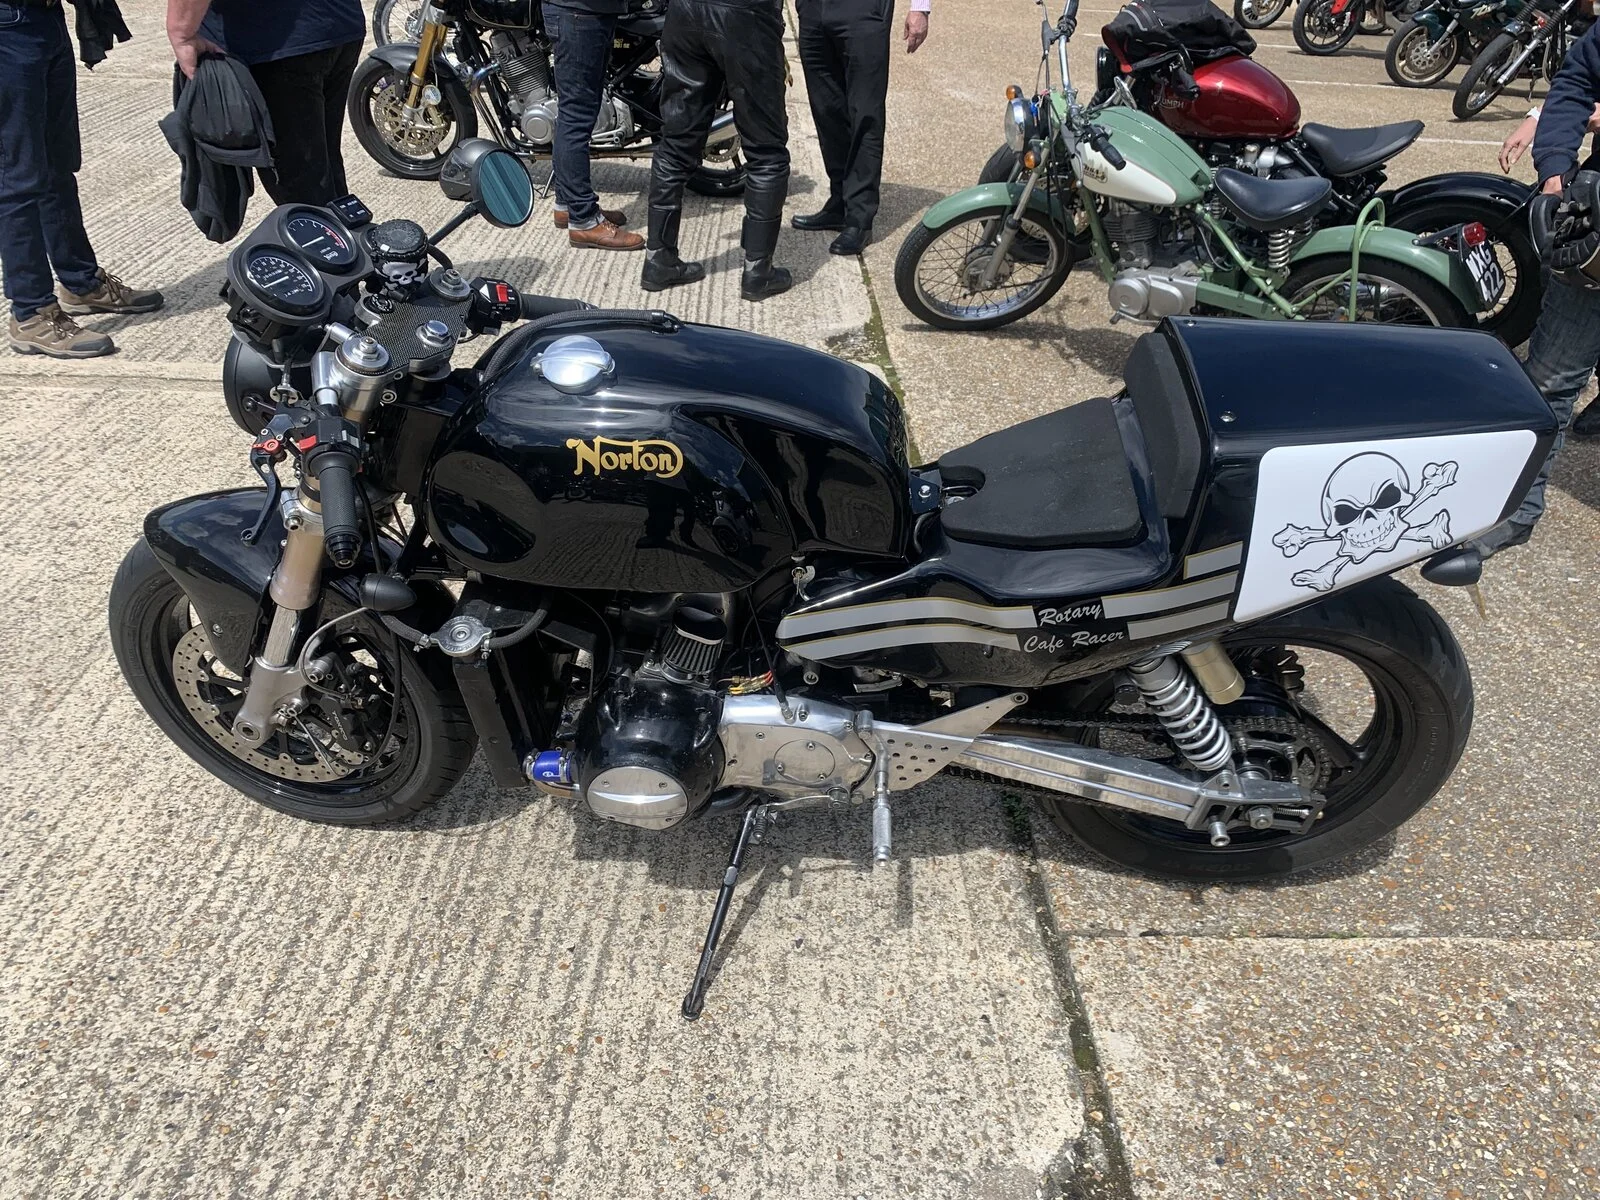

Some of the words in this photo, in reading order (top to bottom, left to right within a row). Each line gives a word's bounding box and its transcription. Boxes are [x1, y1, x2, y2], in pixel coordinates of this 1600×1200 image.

[1480, 262, 1504, 303] 422
[565, 435, 684, 479] Norton
[1038, 604, 1102, 627] Rotary
[1023, 635, 1064, 653] Cafe
[1070, 630, 1124, 647] Racer
